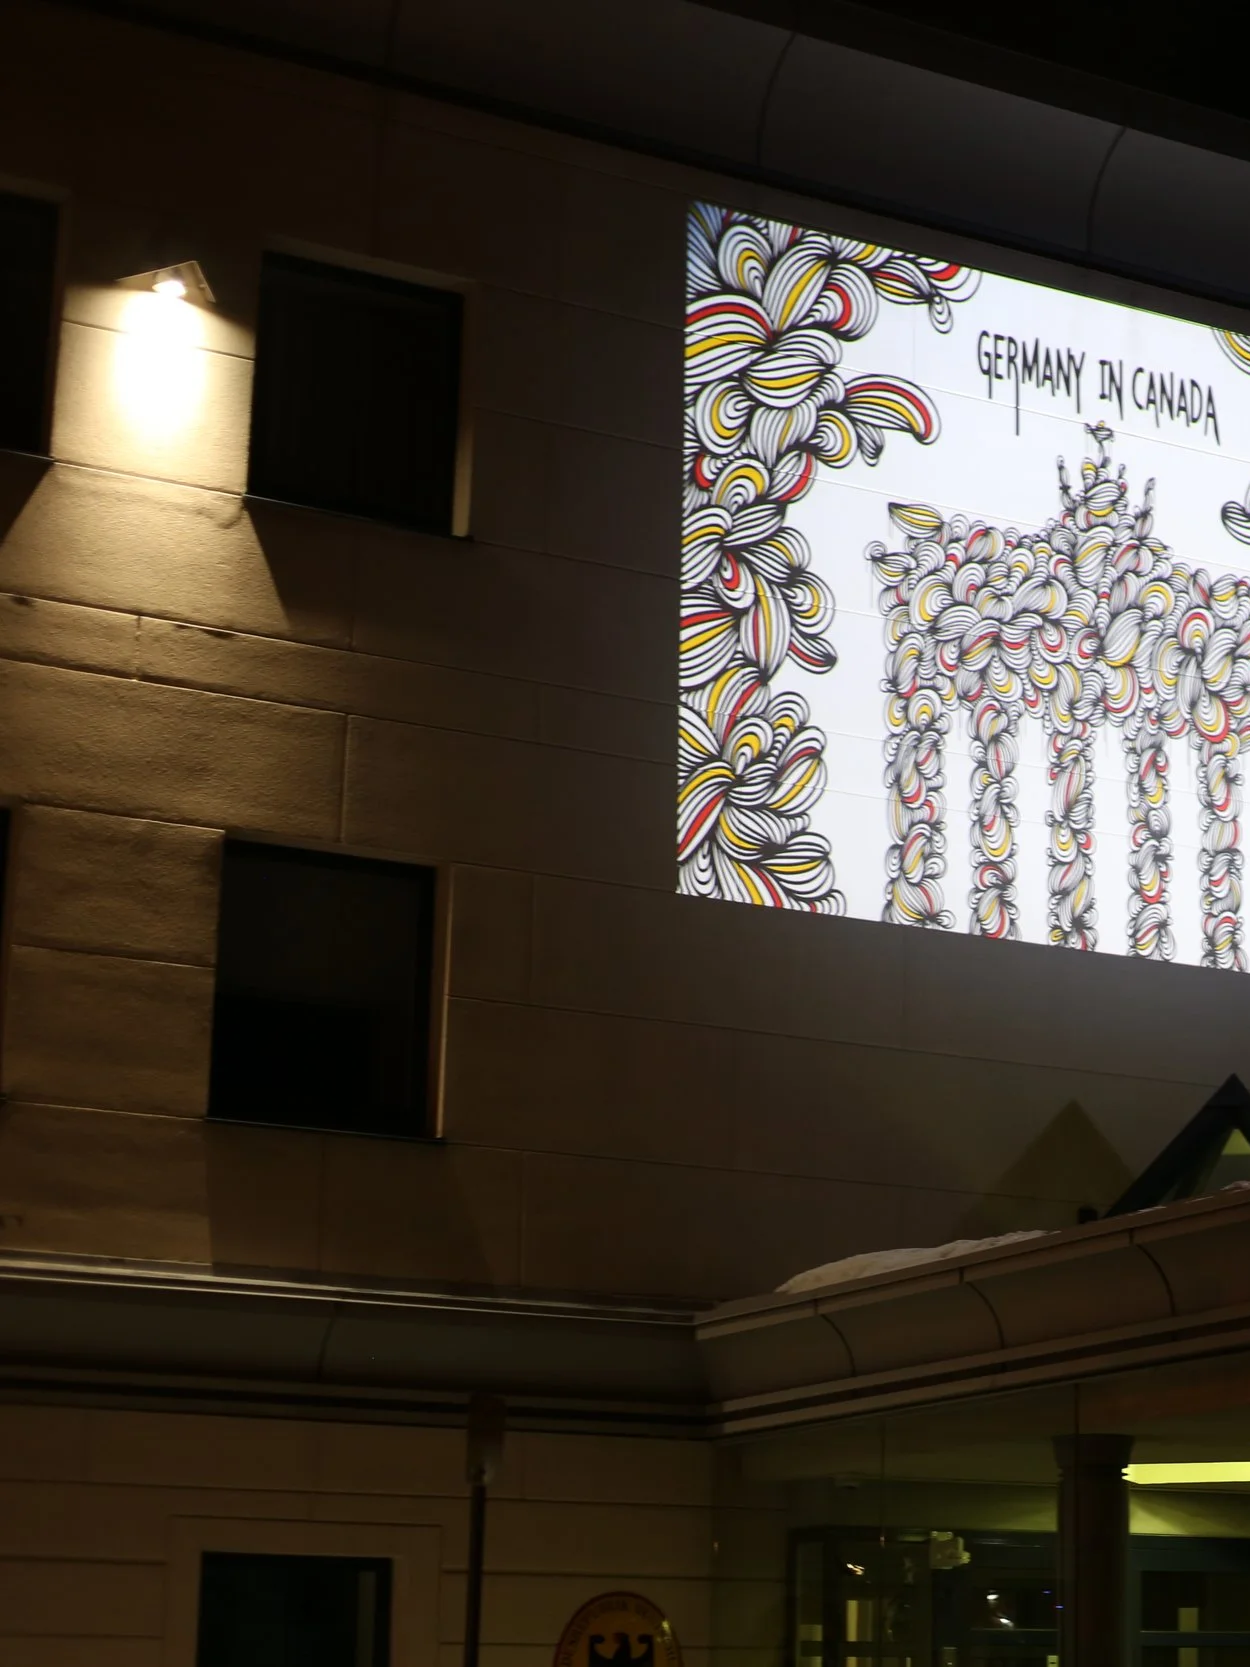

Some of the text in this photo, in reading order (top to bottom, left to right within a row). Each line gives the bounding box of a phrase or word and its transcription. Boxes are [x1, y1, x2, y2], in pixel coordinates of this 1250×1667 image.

[977, 330, 1221, 446] GERMANY IN CANADA
